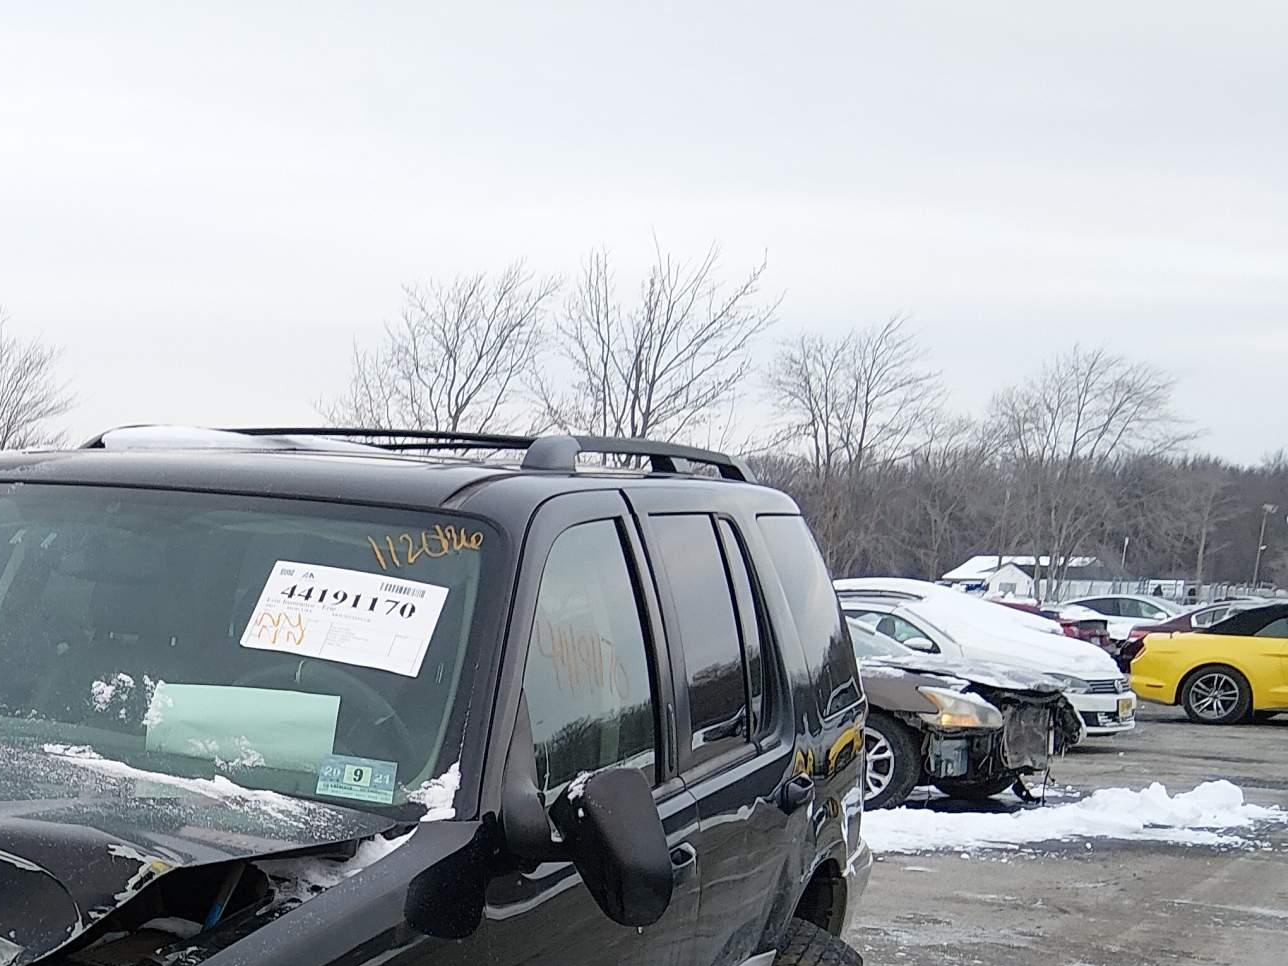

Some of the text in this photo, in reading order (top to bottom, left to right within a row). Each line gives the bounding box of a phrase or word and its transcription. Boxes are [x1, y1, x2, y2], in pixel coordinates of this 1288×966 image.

[280, 584, 416, 619] 44191170
[324, 766, 341, 777] 20
[352, 768, 364, 783] 9
